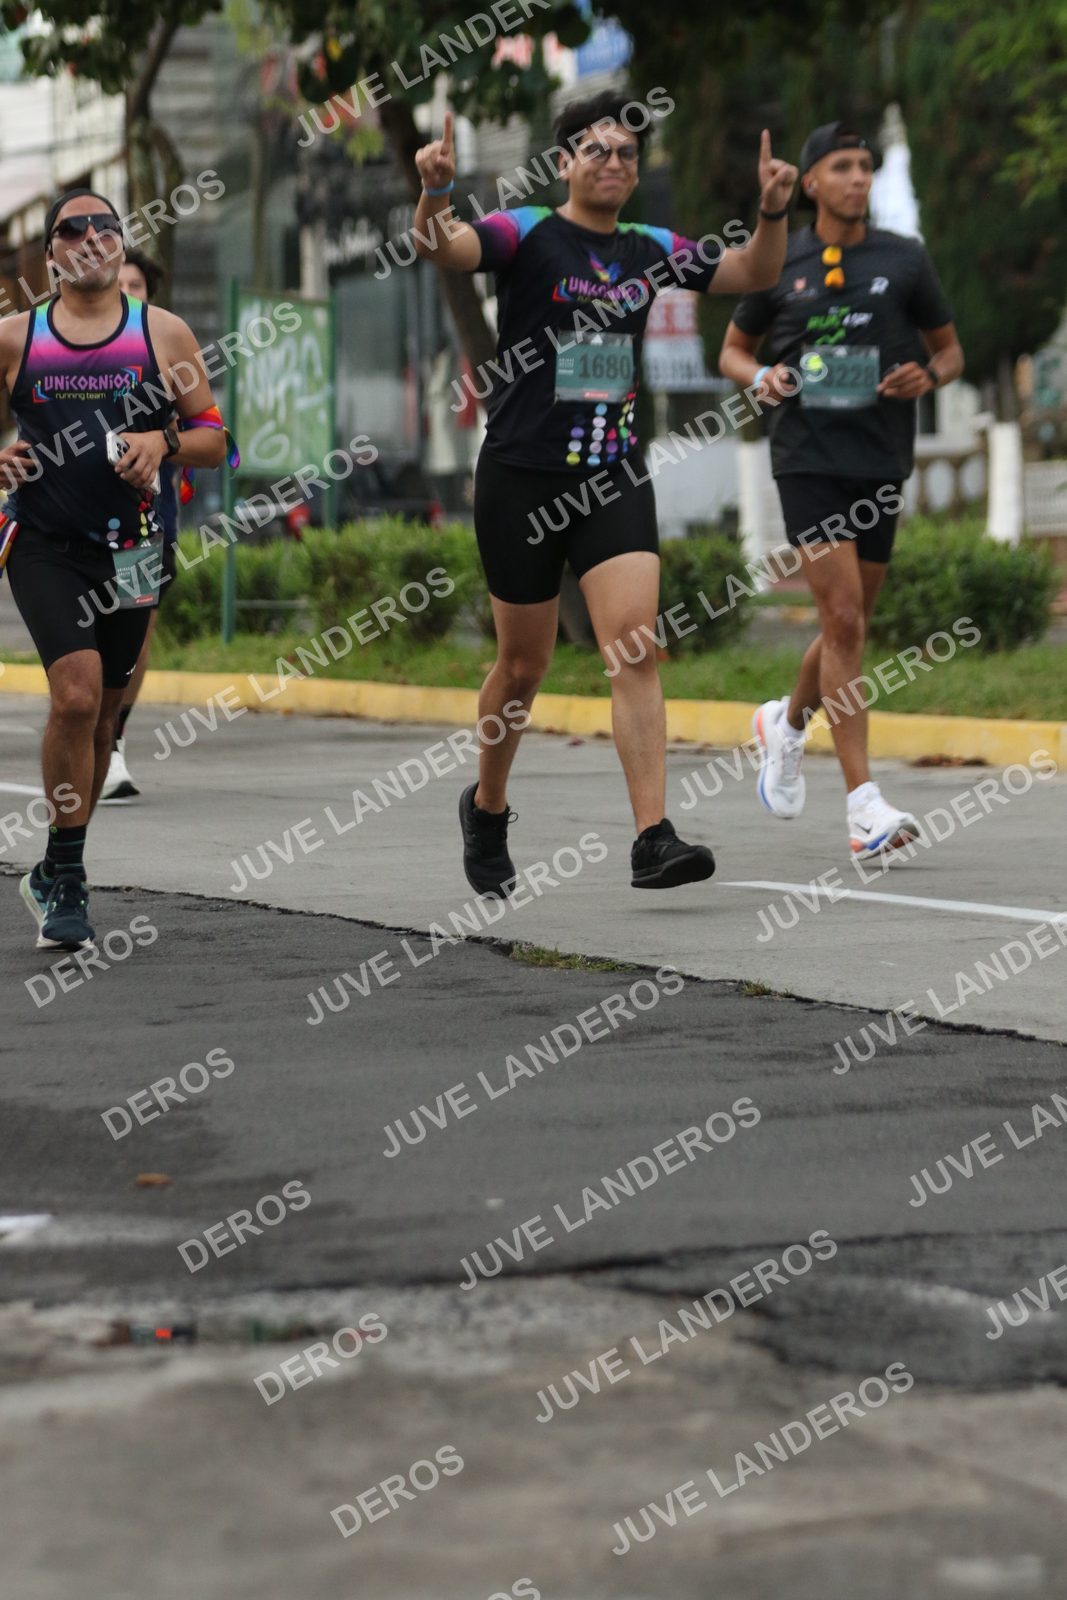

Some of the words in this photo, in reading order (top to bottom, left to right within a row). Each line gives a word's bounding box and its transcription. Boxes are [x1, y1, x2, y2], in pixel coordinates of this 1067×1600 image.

[578, 353, 631, 380] 1680
[55, 391, 86, 401] running
[86, 391, 106, 400] team
